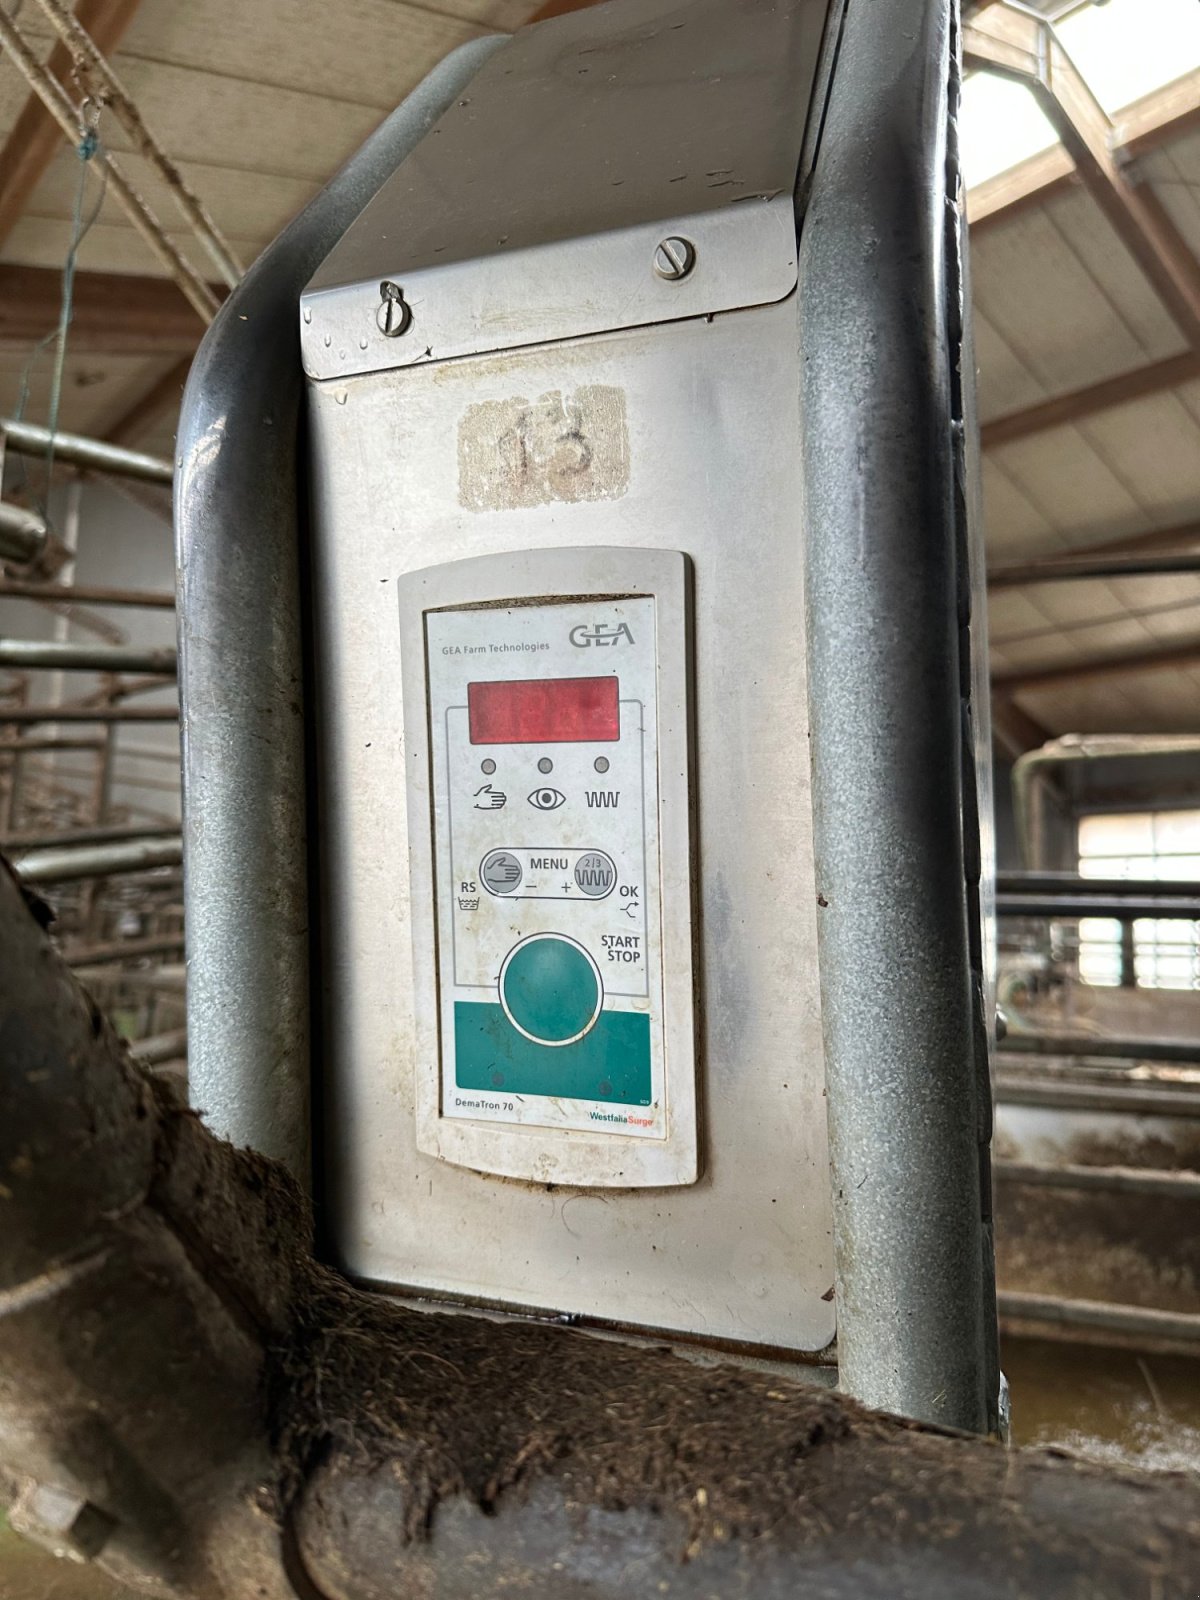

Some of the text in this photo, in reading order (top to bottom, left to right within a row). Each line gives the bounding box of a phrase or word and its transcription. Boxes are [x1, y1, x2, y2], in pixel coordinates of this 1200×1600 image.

[568, 622, 635, 648] GEA
[442, 642, 550, 655] GEA Farm Technologies
[530, 858, 568, 870] MENU
[461, 881, 476, 893] RS
[619, 885, 639, 898] OK
[601, 935, 640, 949] START
[608, 950, 641, 963] STOP
[455, 1098, 514, 1111] DemaTron 70
[589, 1111, 653, 1127] WestfaliaSurge
